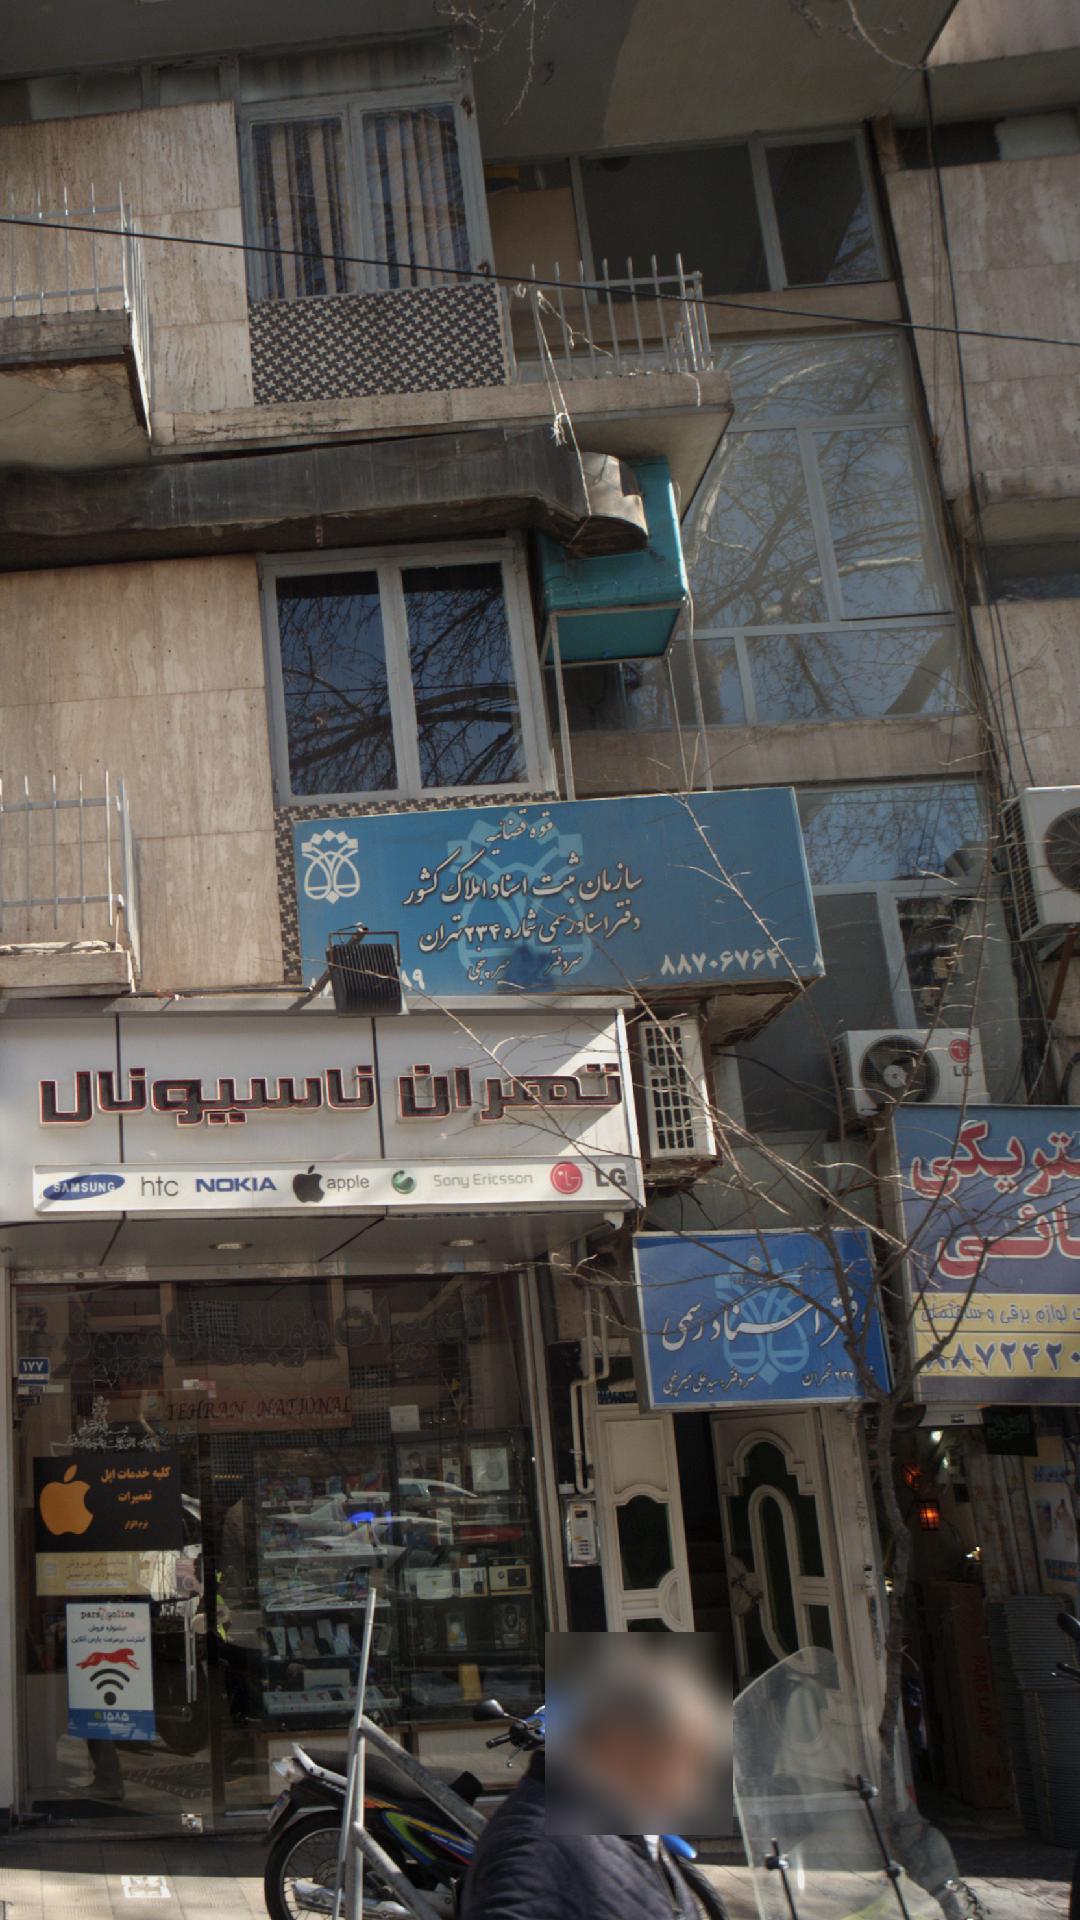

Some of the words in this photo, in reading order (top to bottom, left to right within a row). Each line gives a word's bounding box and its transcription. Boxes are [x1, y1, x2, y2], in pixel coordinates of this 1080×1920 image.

[403, 847, 462, 905] کشور
[531, 850, 580, 905] ثبت
[578, 862, 643, 901] سازمان
[418, 913, 463, 952] تهران
[605, 899, 642, 939] دفتر
[39, 1064, 376, 1126] ناسیونال
[396, 1062, 624, 1122] تهران
[52, 1180, 117, 1194] SAMSUNG
[140, 1175, 181, 1198] htc
[195, 1176, 278, 1193] NOKIA
[325, 1173, 371, 1195] apple
[432, 1173, 471, 1189] Sony
[474, 1171, 535, 1186] Ericsson
[595, 1167, 628, 1188] LG
[910, 1119, 1080, 1198] تریکی
